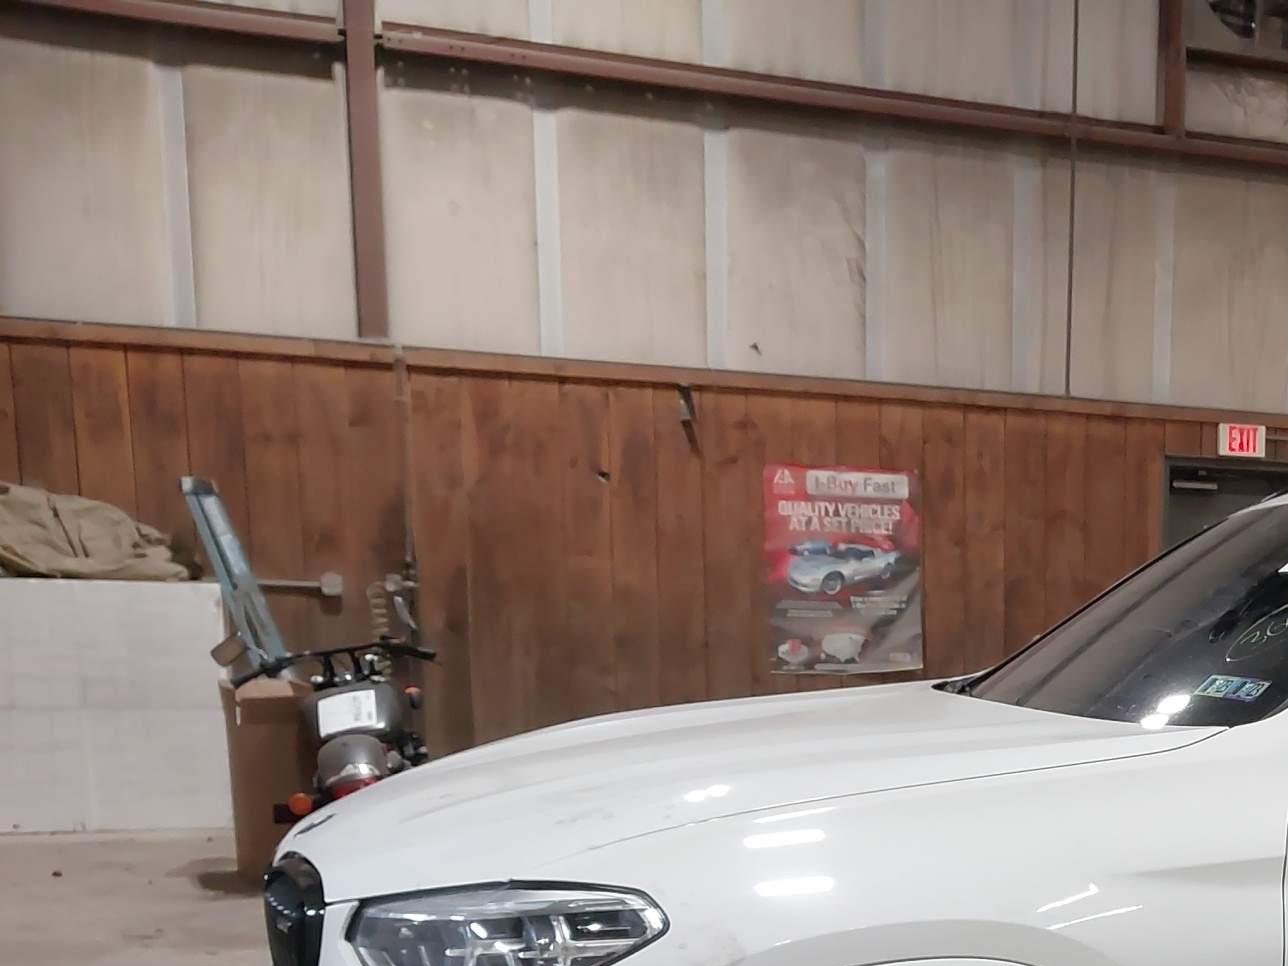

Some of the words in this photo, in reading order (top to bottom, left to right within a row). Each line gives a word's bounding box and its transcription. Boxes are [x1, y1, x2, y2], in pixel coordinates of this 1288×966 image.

[1228, 425, 1258, 453] EXIT
[814, 475, 857, 494] I-Buy
[863, 477, 896, 493] Fast
[778, 500, 836, 517] QUALITY
[837, 502, 901, 520] VEHICLES
[808, 516, 821, 531] A
